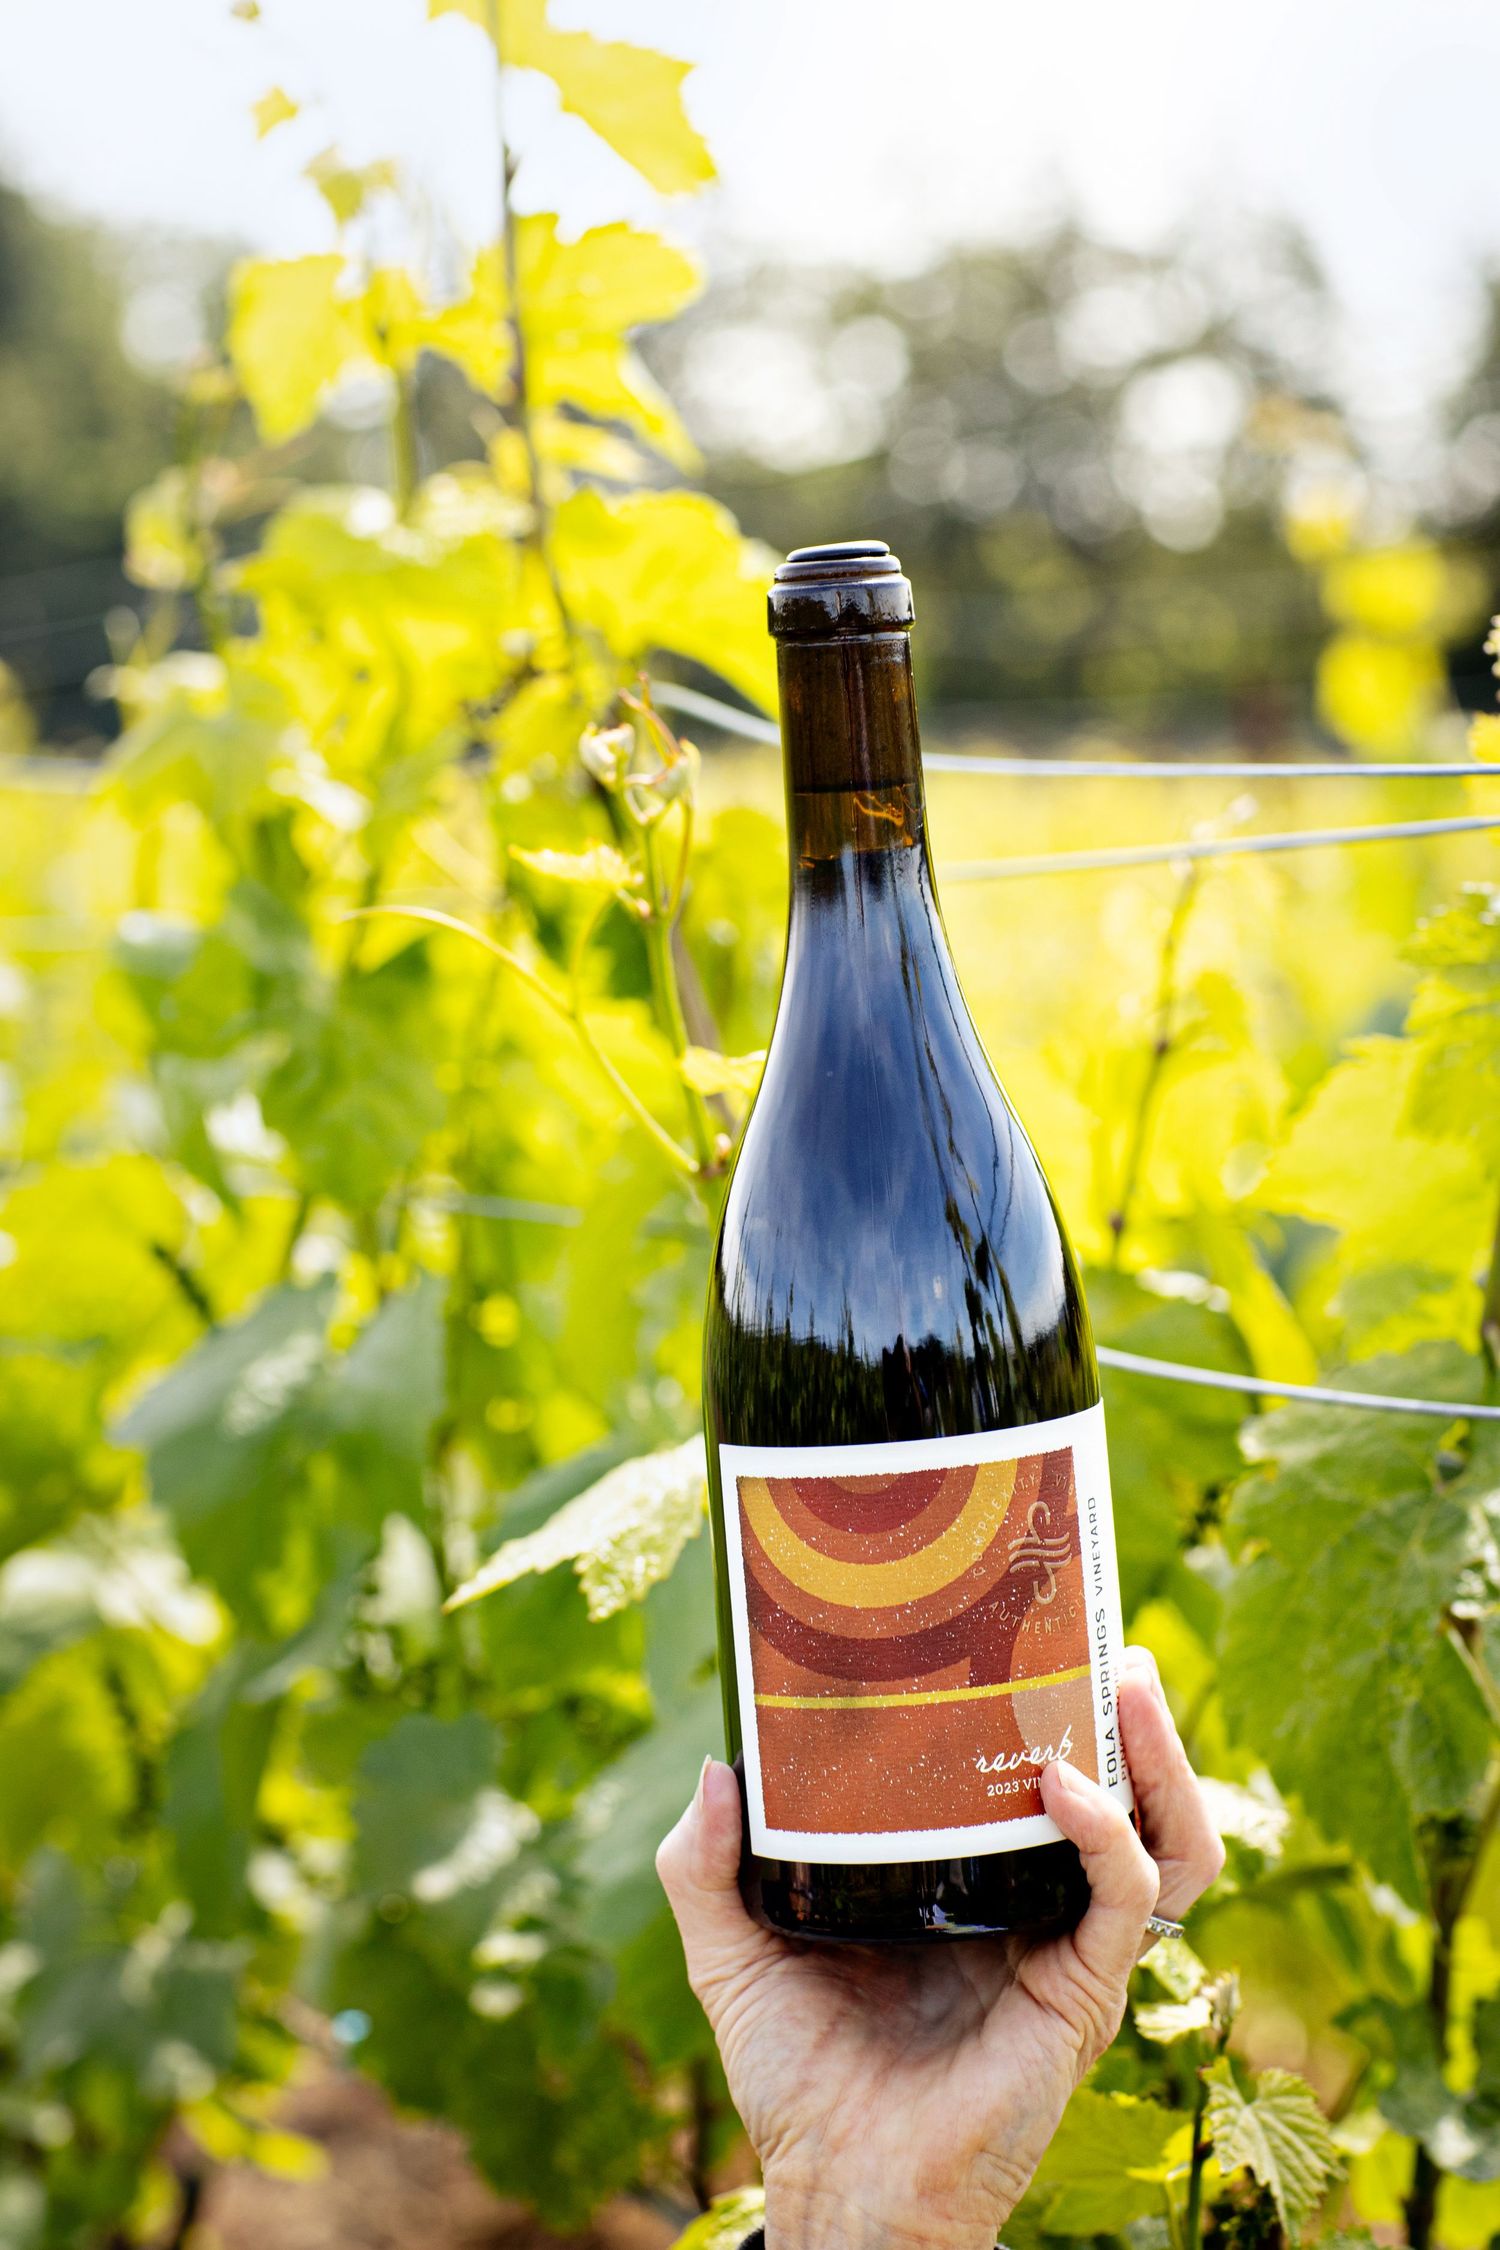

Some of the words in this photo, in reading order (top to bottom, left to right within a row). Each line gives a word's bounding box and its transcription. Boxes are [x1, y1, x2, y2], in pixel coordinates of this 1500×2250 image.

[1087, 1497, 1103, 1596] VINEYARD
[1096, 1608, 1113, 1716] SPRINGS
[974, 1724, 1074, 1774] reverb
[1105, 1727, 1118, 1788] EOLA
[986, 1780, 1020, 1797] 2023
